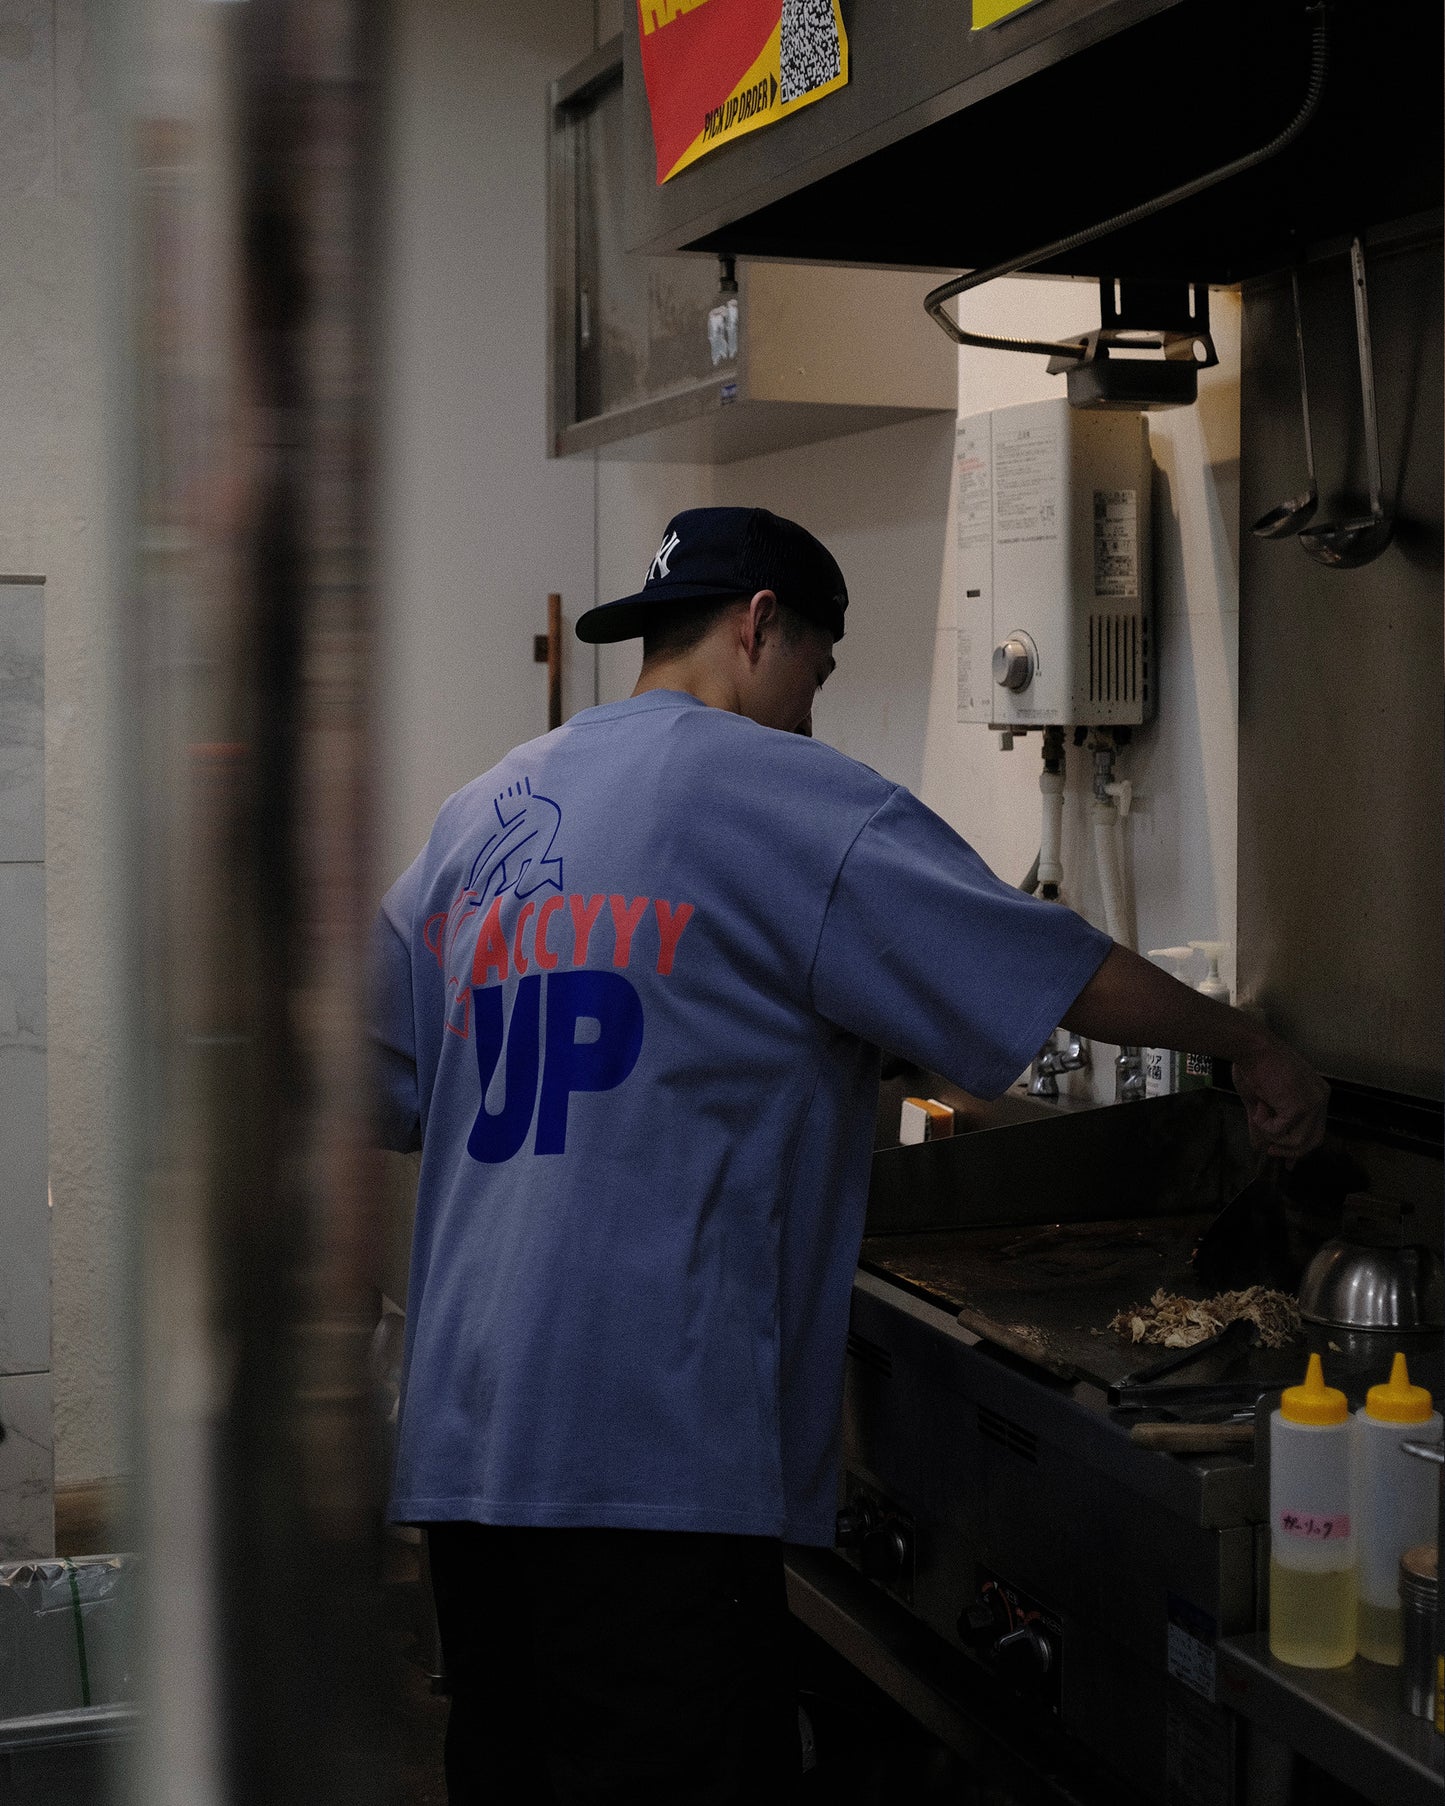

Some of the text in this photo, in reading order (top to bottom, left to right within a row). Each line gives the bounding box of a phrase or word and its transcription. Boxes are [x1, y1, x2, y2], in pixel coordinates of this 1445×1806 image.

[702, 78, 768, 143] PICK UP ORDER
[466, 969, 644, 1164] UP
